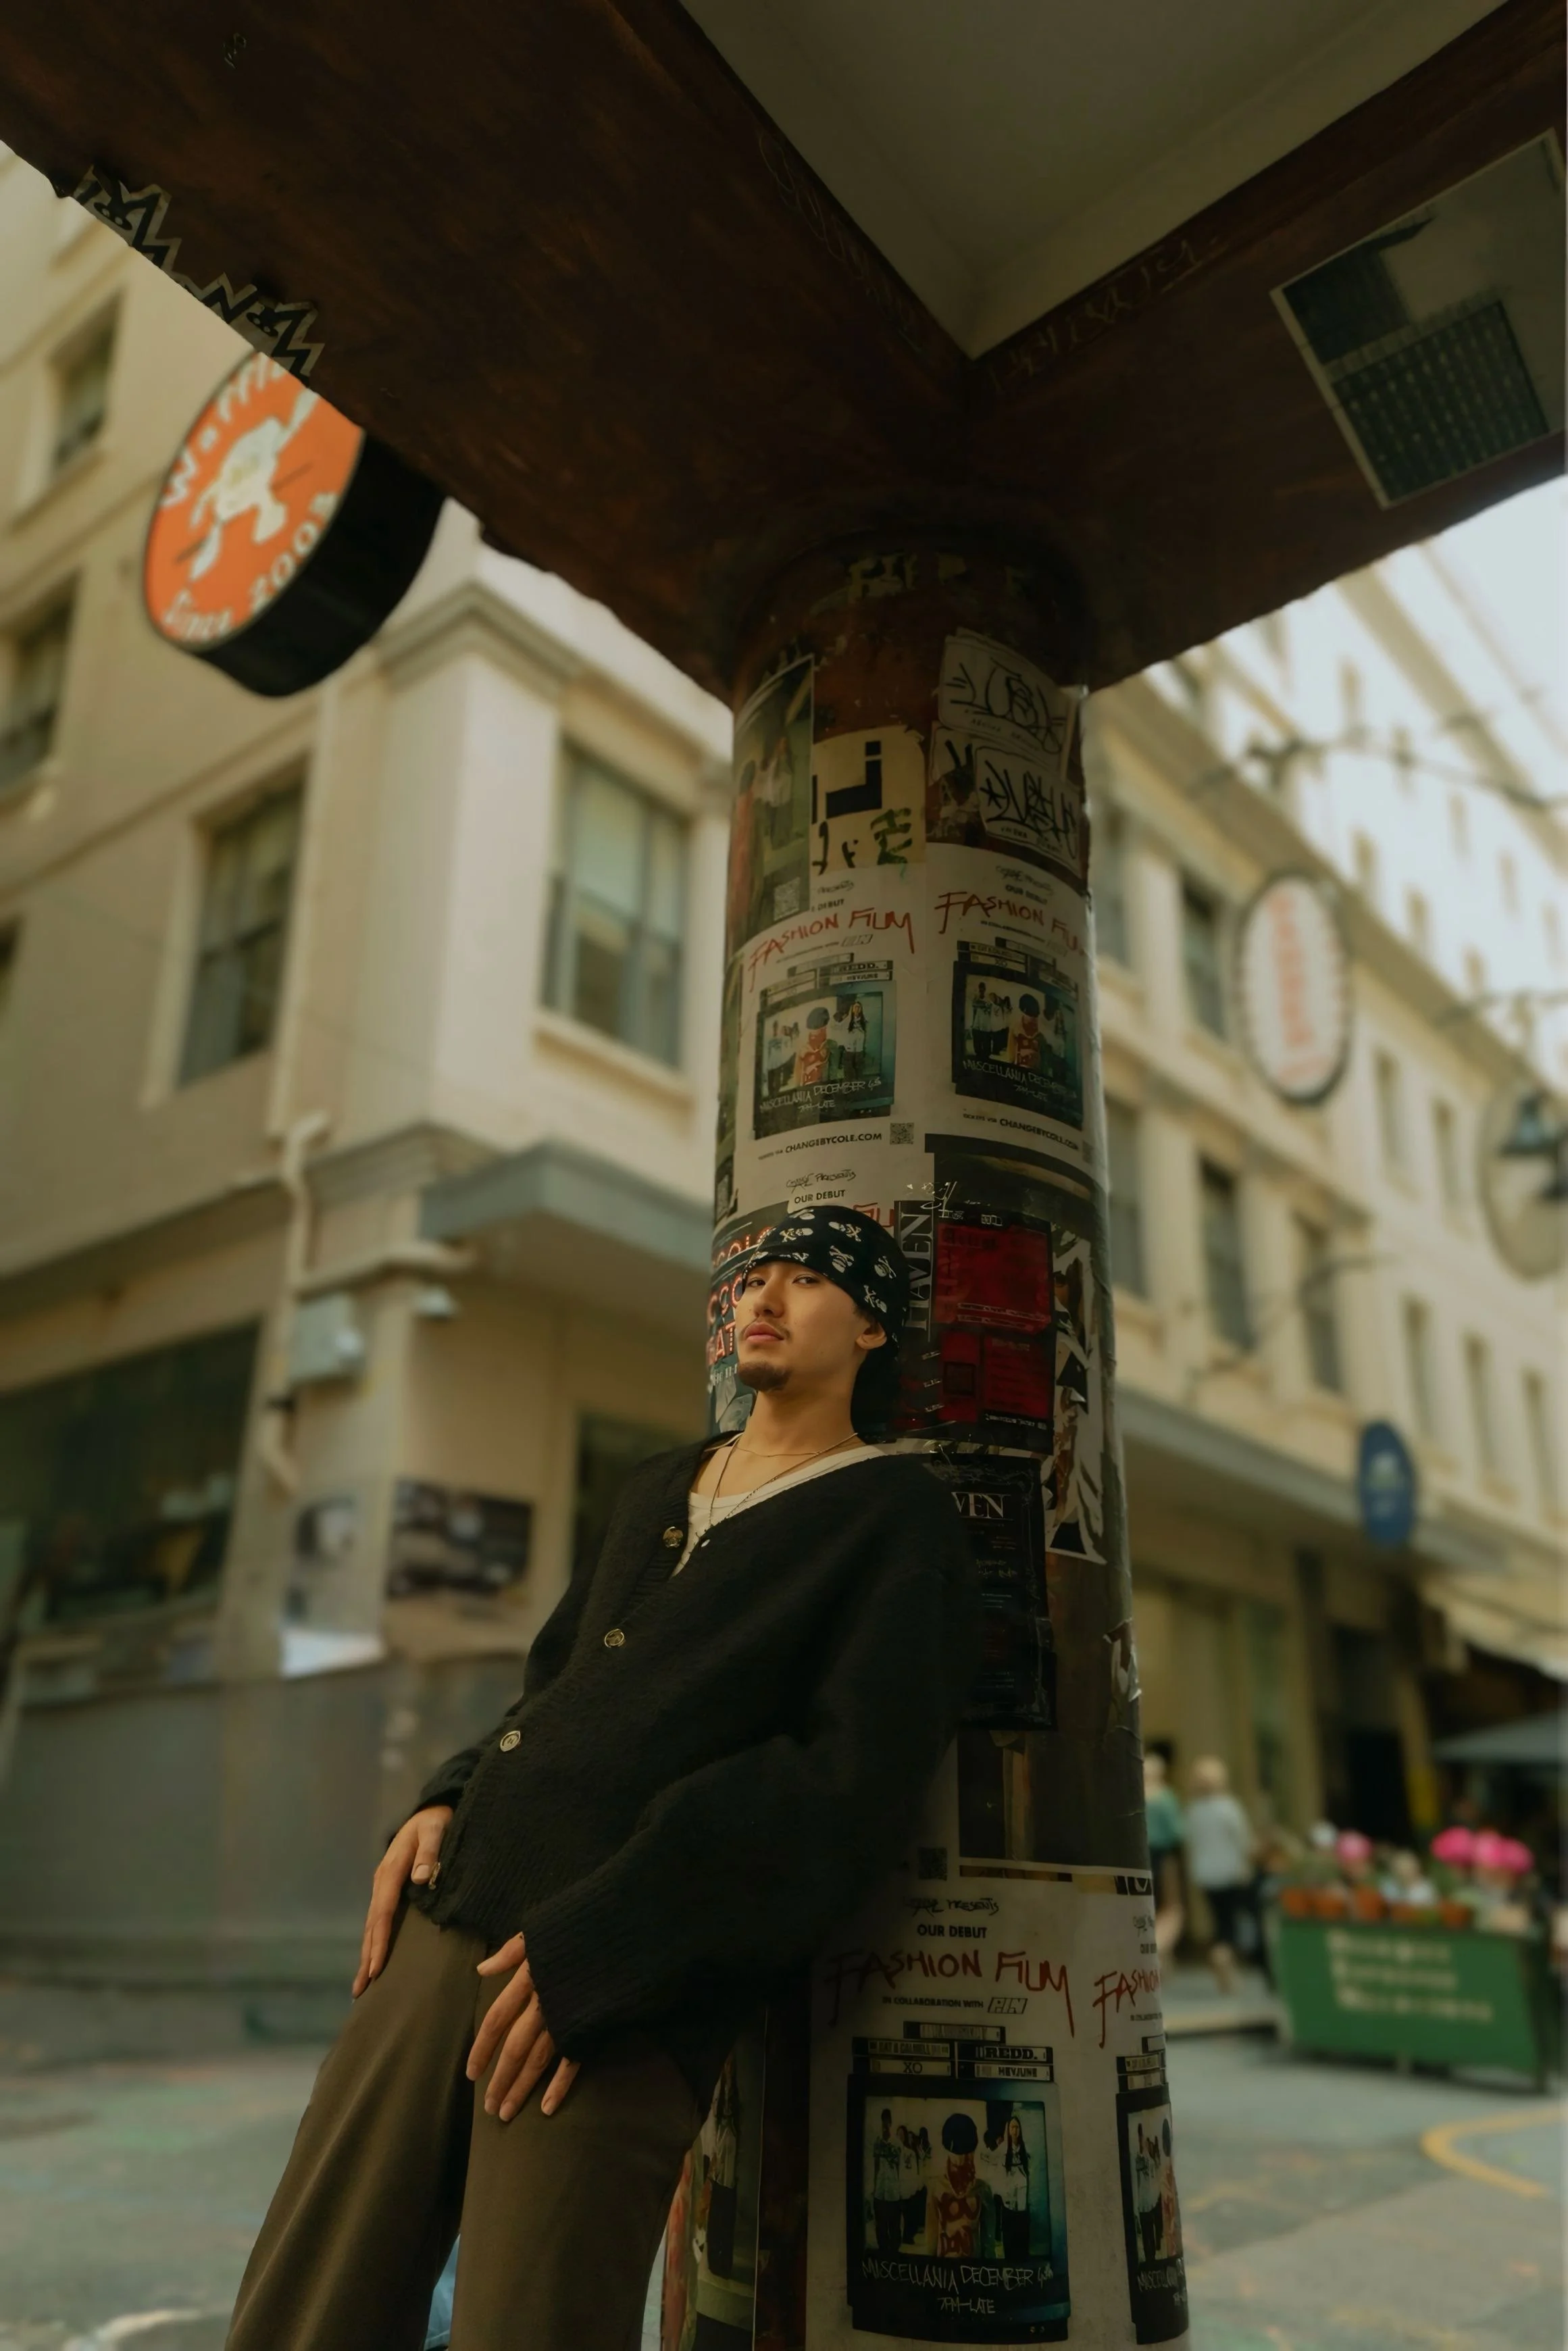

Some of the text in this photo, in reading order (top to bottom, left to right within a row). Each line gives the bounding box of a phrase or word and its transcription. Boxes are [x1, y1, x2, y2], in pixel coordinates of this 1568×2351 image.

[934, 891, 1044, 934] FASHION
[748, 907, 915, 993] FASHION FILM
[813, 1081, 865, 1096] DECEMBER
[786, 1133, 883, 1153] CHANGEBYCOLE.COM
[794, 1190, 846, 1205] OUR DEBUT
[951, 1492, 1006, 1519] VEN
[917, 1924, 988, 1939] OUR DEBUT
[824, 1948, 1075, 2039] FASHION FILM
[882, 1996, 892, 2004] IN
[894, 1996, 961, 2008] COLLABORATION
[963, 2000, 984, 2008] WITH
[985, 2048, 1038, 2060] REDD.
[903, 2061, 923, 2074] XO
[860, 2256, 959, 2294] MISCELLANIA
[960, 2264, 1034, 2291] DECEMBER
